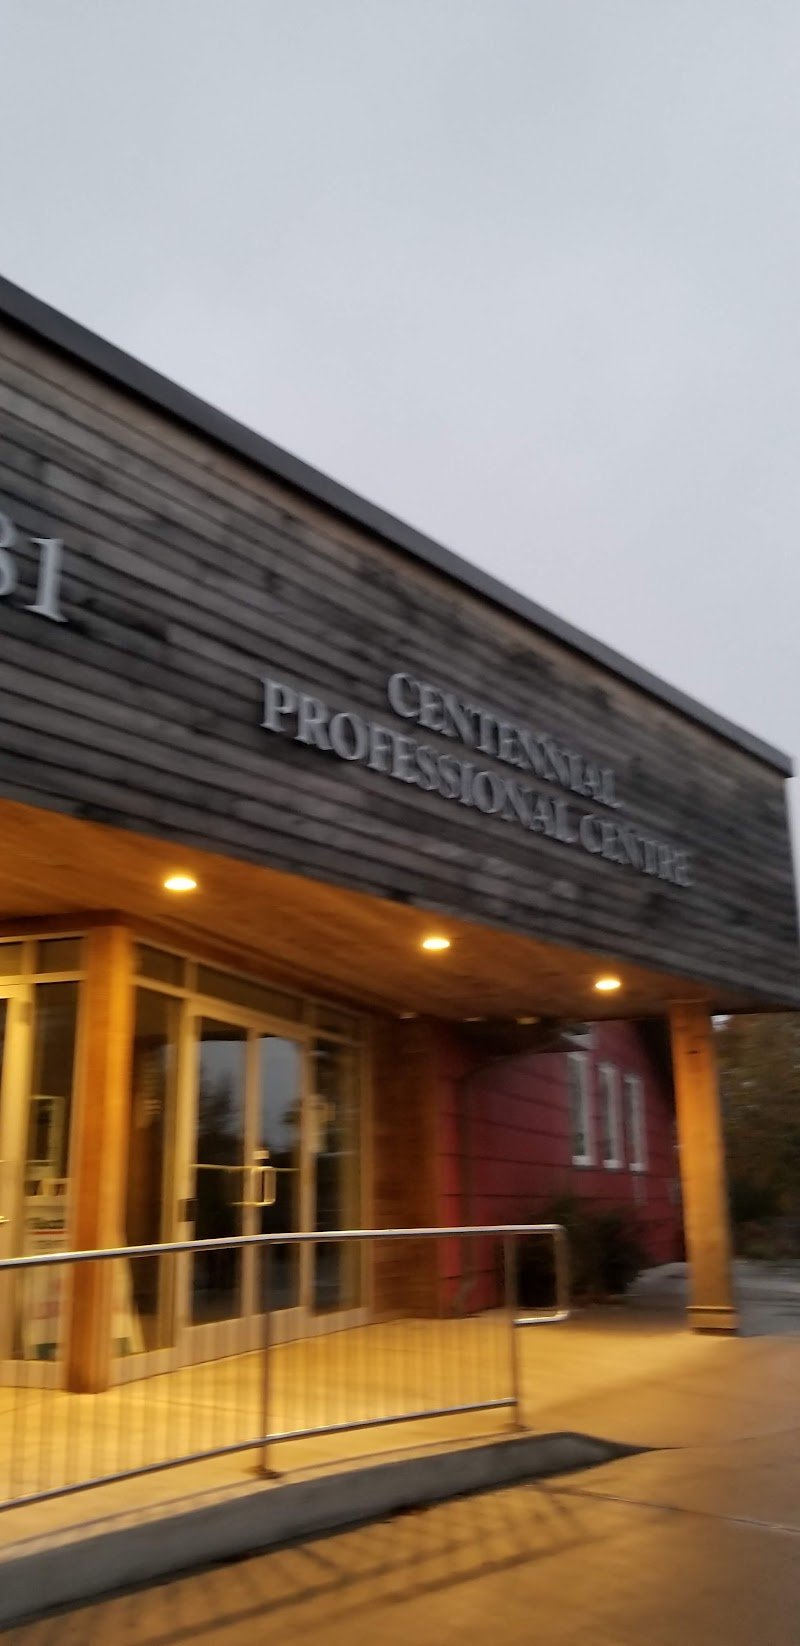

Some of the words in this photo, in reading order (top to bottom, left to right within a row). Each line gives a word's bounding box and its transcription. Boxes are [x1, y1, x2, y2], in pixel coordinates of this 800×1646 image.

[261, 677, 577, 844] PROFESSIONAL
[579, 814, 692, 887] CENTRE
[387, 672, 622, 808] CENTENNIAL
